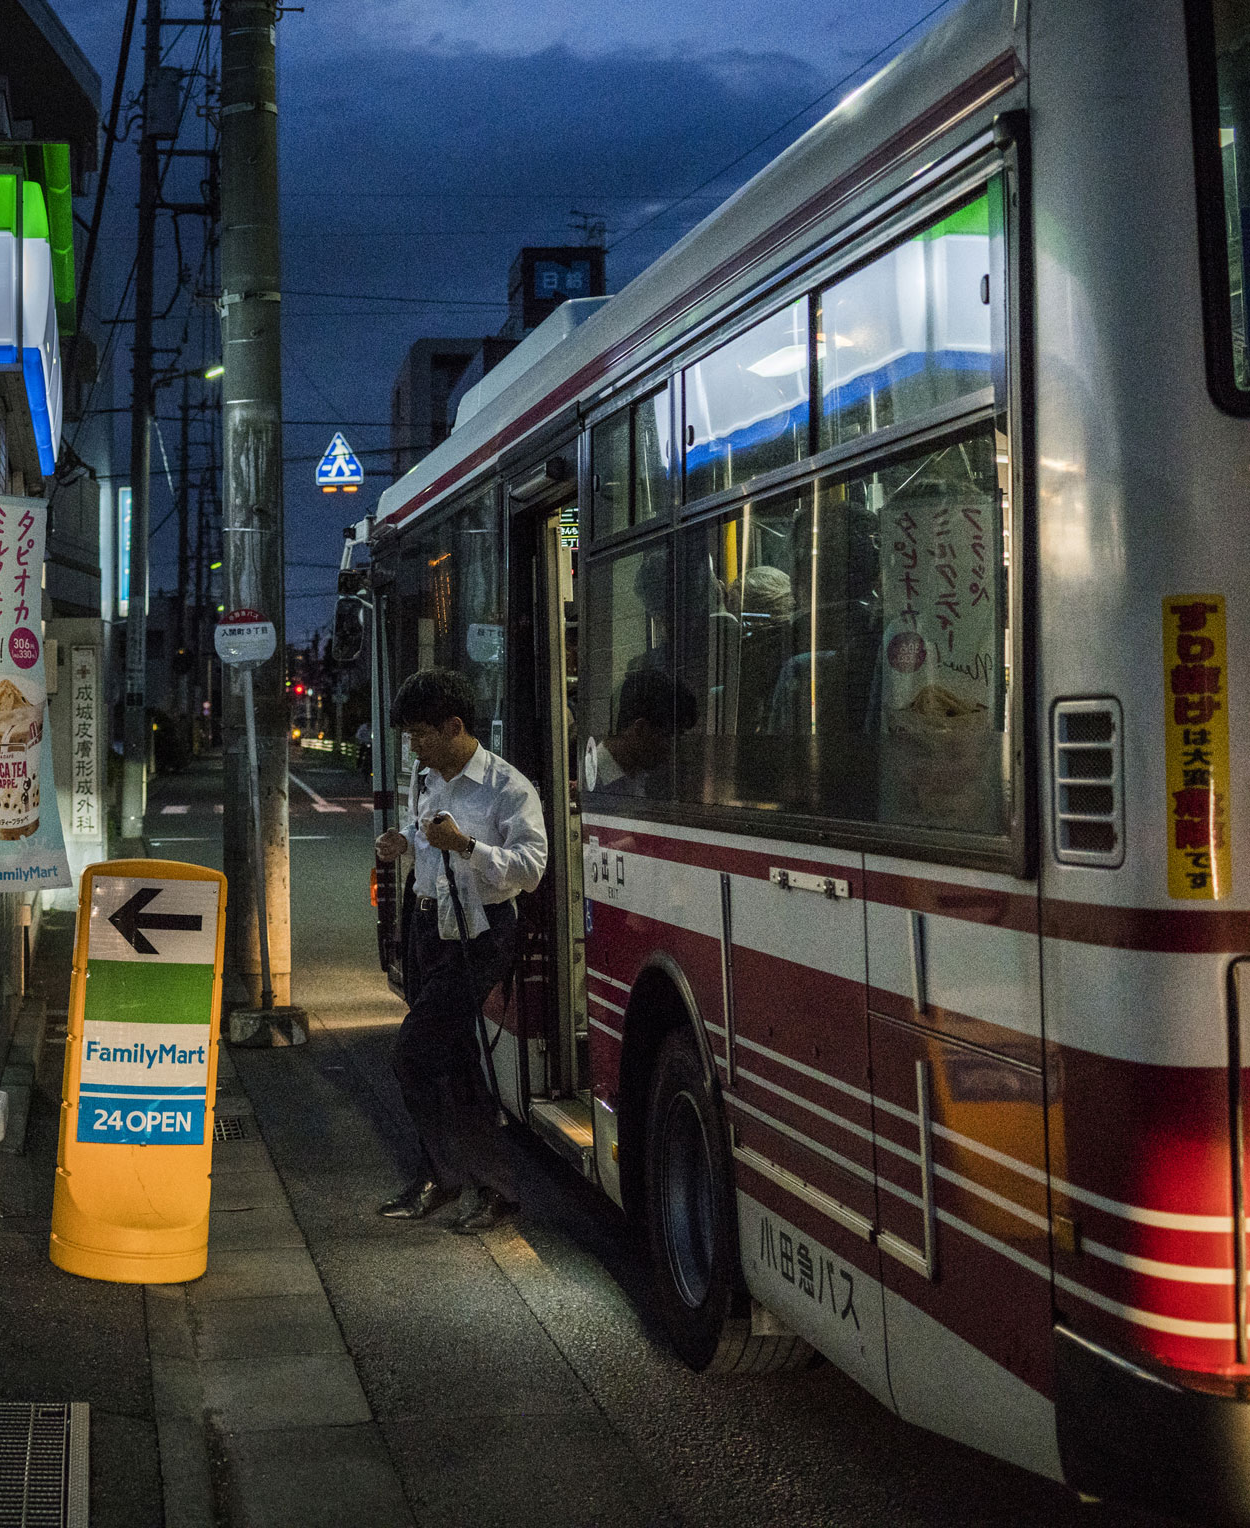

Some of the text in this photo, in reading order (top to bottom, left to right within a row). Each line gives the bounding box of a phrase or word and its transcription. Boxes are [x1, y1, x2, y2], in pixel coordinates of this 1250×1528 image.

[14, 510, 35, 625] タピオカ
[12, 760, 28, 778] TEA
[74, 684, 95, 833] 成城皮膚形成外科
[601, 852, 625, 887] 出口
[86, 1041, 205, 1070] FamilyMart
[760, 1216, 860, 1331] 小田急バス
